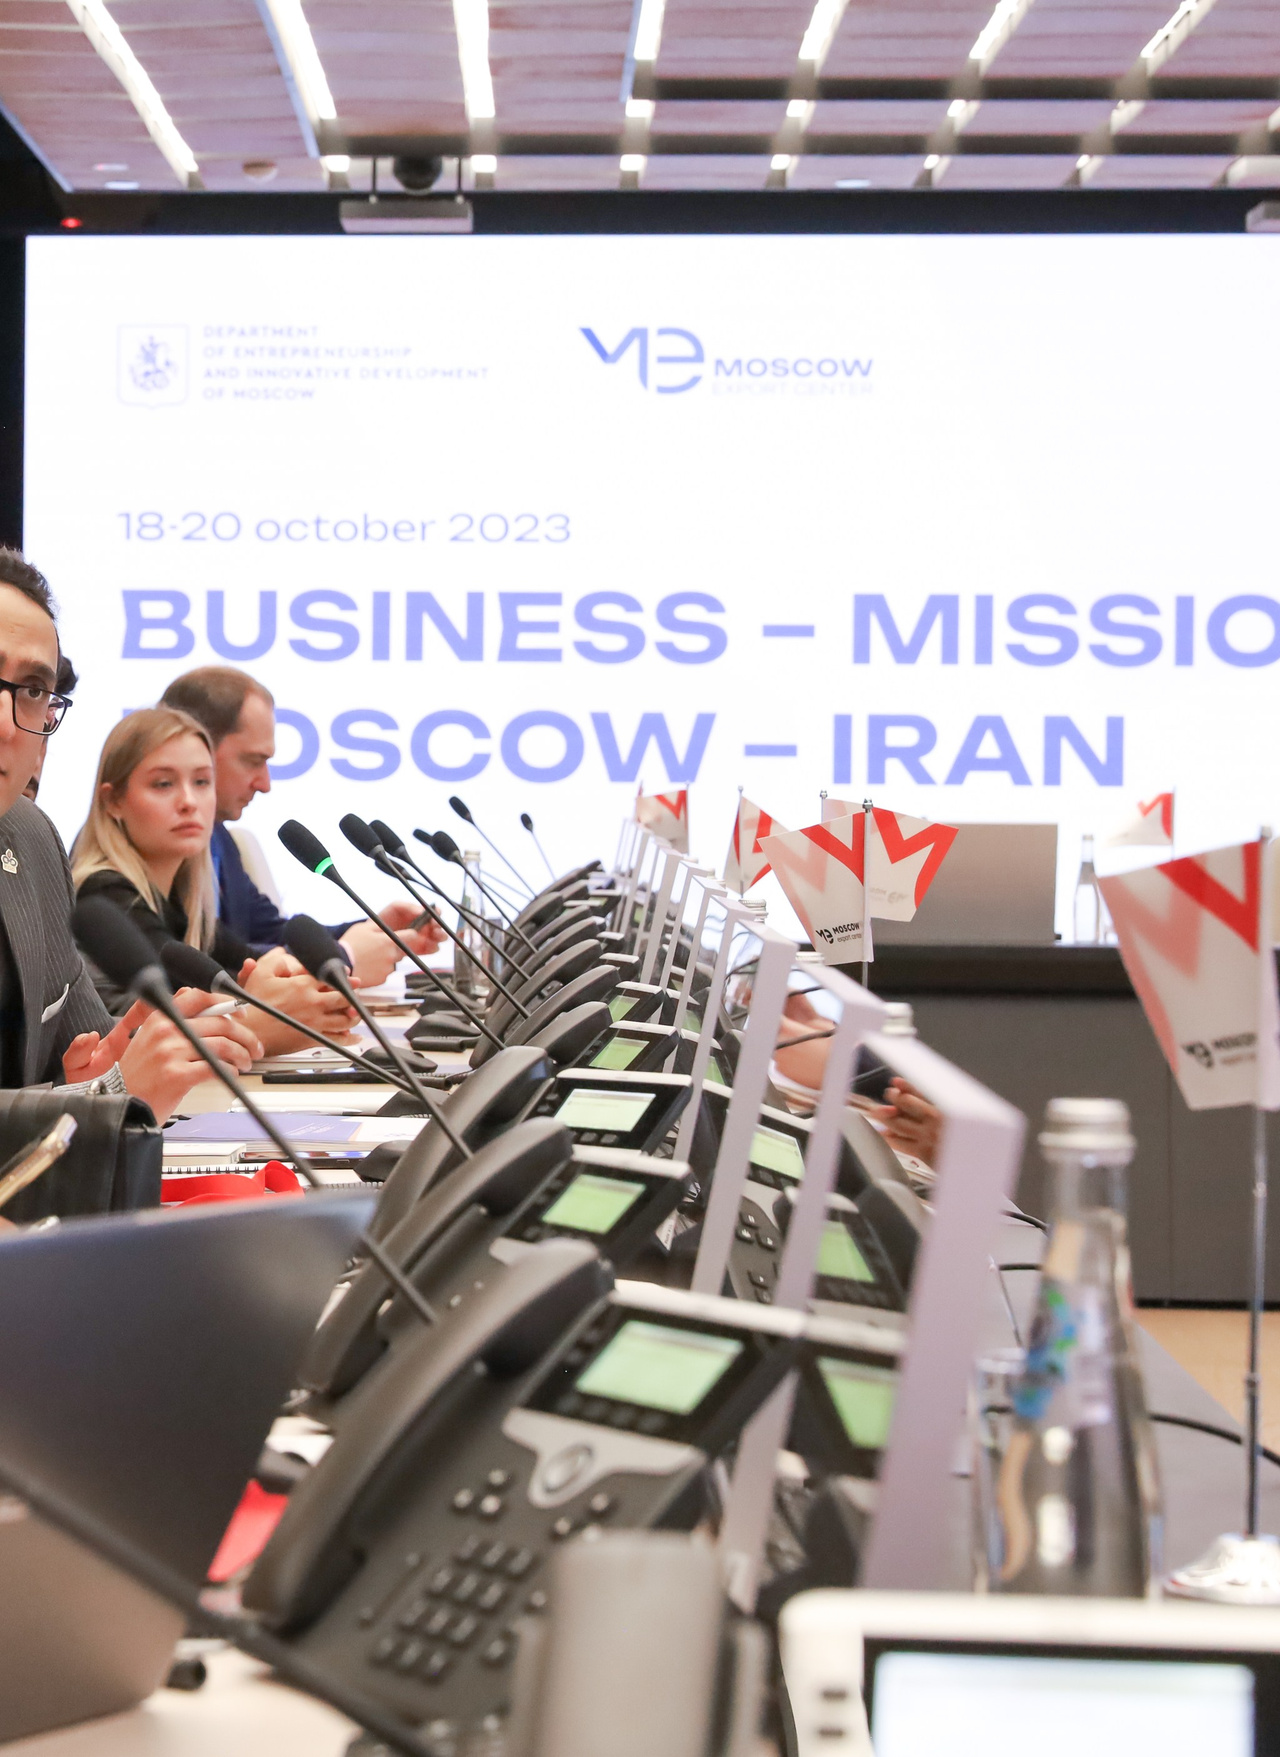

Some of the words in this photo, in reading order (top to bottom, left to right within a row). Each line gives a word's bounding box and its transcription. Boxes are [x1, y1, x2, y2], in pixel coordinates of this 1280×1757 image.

[203, 325, 318, 339] DEPARTMENT
[203, 345, 225, 359] OF
[233, 346, 412, 360] ENTREPRENEURSHIP
[203, 366, 240, 379] AND
[246, 366, 351, 379] INNOVATIVE
[360, 366, 489, 379] DEVELOPMENT
[714, 358, 874, 378] MOSCOW
[202, 387, 225, 400] OF
[232, 387, 315, 400] MOSCOW
[711, 381, 788, 396] EXPORT
[793, 381, 874, 396] CENTER
[118, 511, 242, 543] 18-20
[255, 511, 435, 543] october
[449, 512, 572, 543] 2023
[121, 589, 728, 665] BUSINESS
[122, 708, 715, 783] OSCOW
[834, 715, 1124, 786] IRAN
[832, 922, 860, 935] MOSCOW
